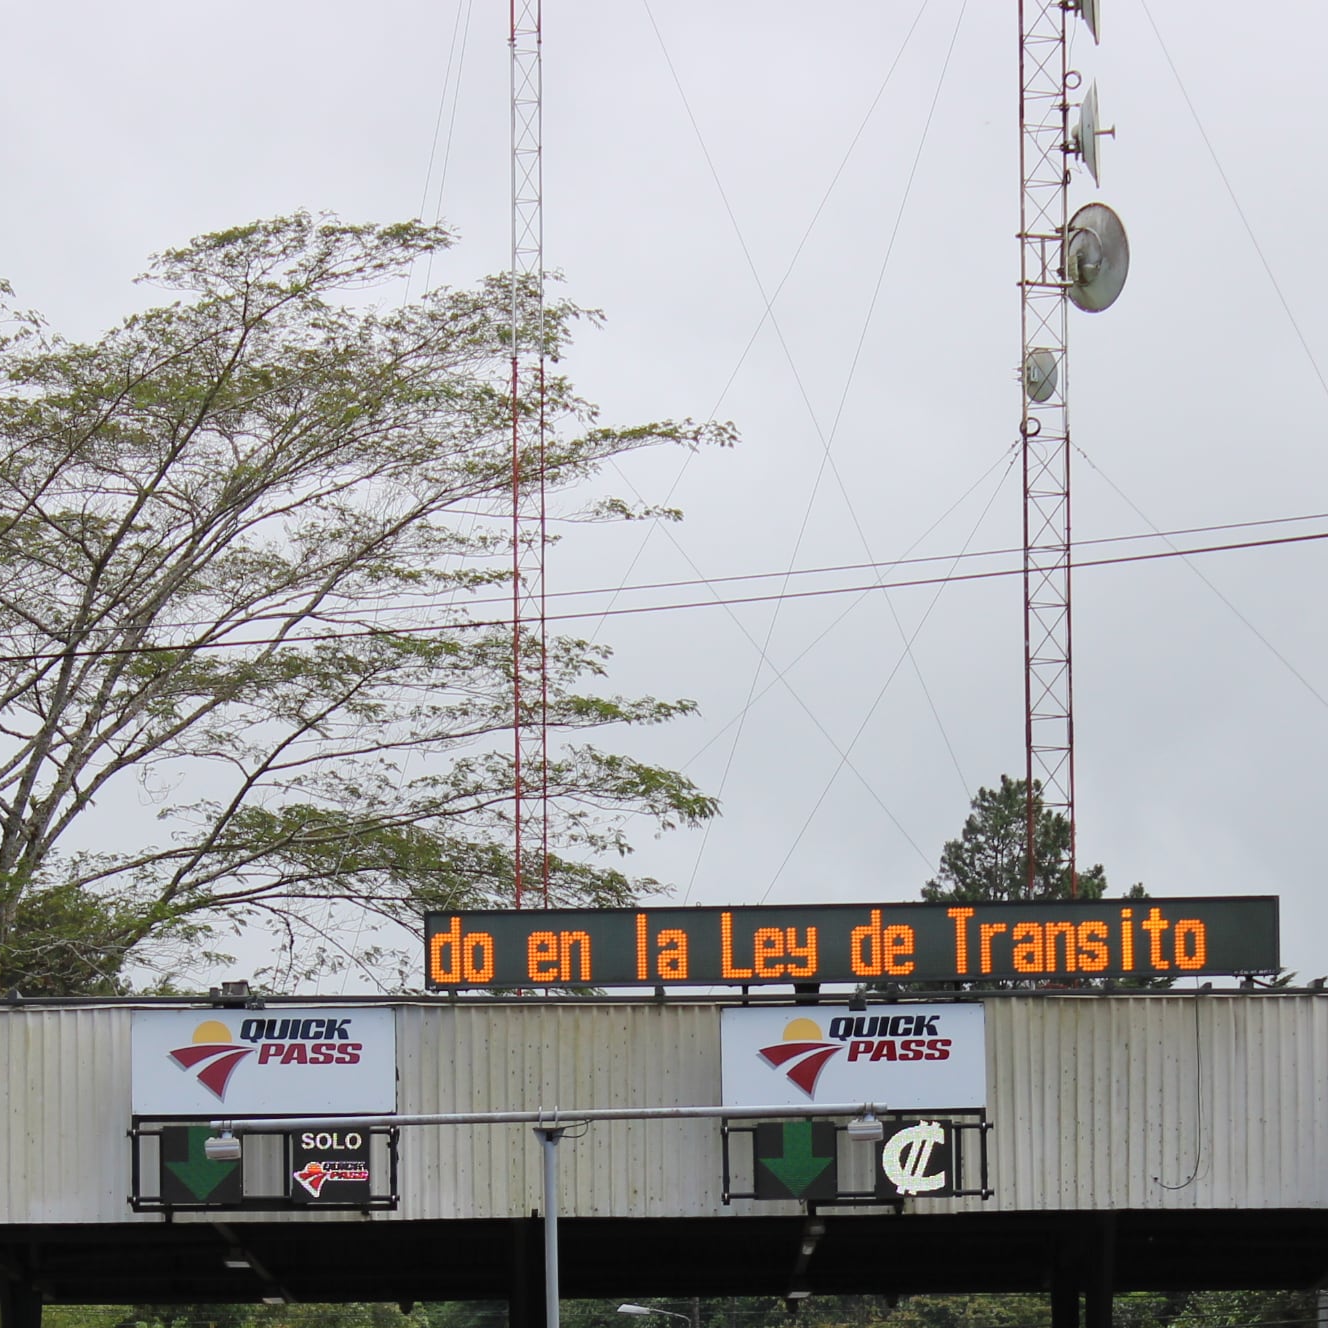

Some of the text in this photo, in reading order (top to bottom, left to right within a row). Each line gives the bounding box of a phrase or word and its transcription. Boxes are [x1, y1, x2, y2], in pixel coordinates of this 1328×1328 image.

[430, 907, 1206, 984] do en la Ley de Transito
[239, 1018, 352, 1041] QUICK
[829, 1015, 941, 1041] QUICK
[257, 1043, 363, 1065] PASS
[847, 1039, 953, 1063] PASS
[301, 1132, 362, 1150] SOLO
